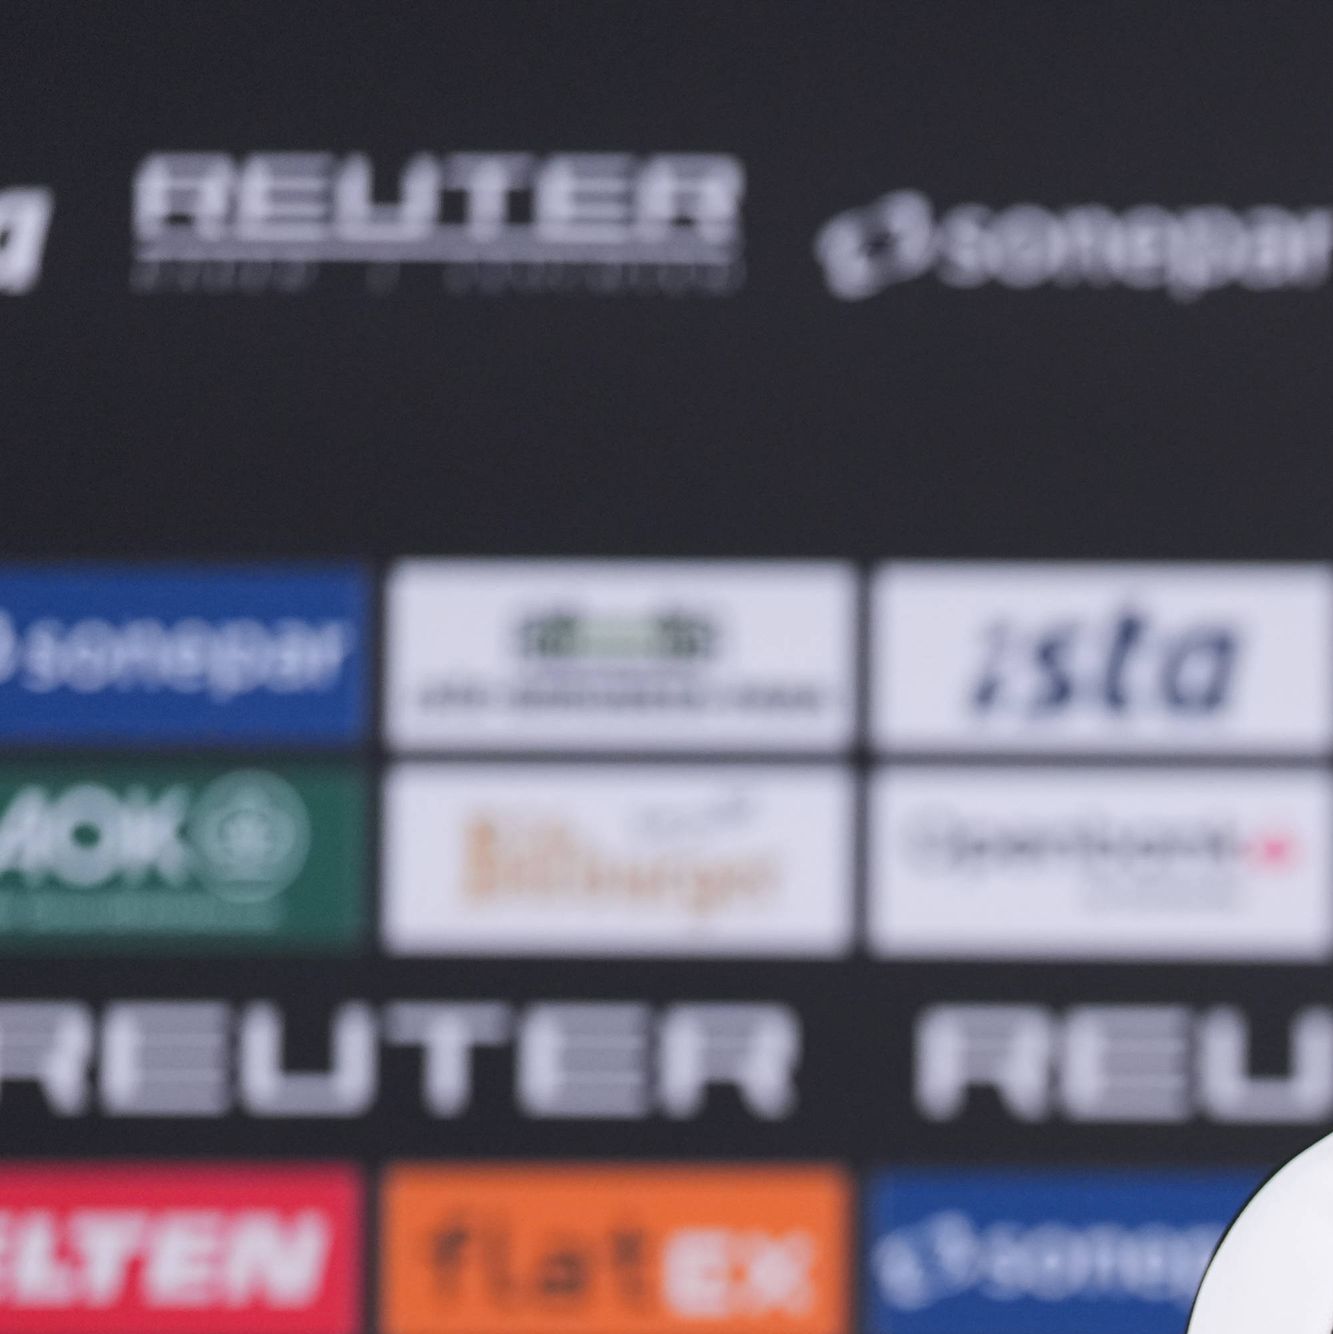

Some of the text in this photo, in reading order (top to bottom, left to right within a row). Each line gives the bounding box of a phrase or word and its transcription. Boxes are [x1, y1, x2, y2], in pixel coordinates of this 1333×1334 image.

[132, 152, 745, 244] REUTER
[20, 617, 350, 705] sonepar
[966, 593, 1241, 721] ista
[0, 1001, 798, 1120] REUTER
[0, 1206, 334, 1312] LTEN
